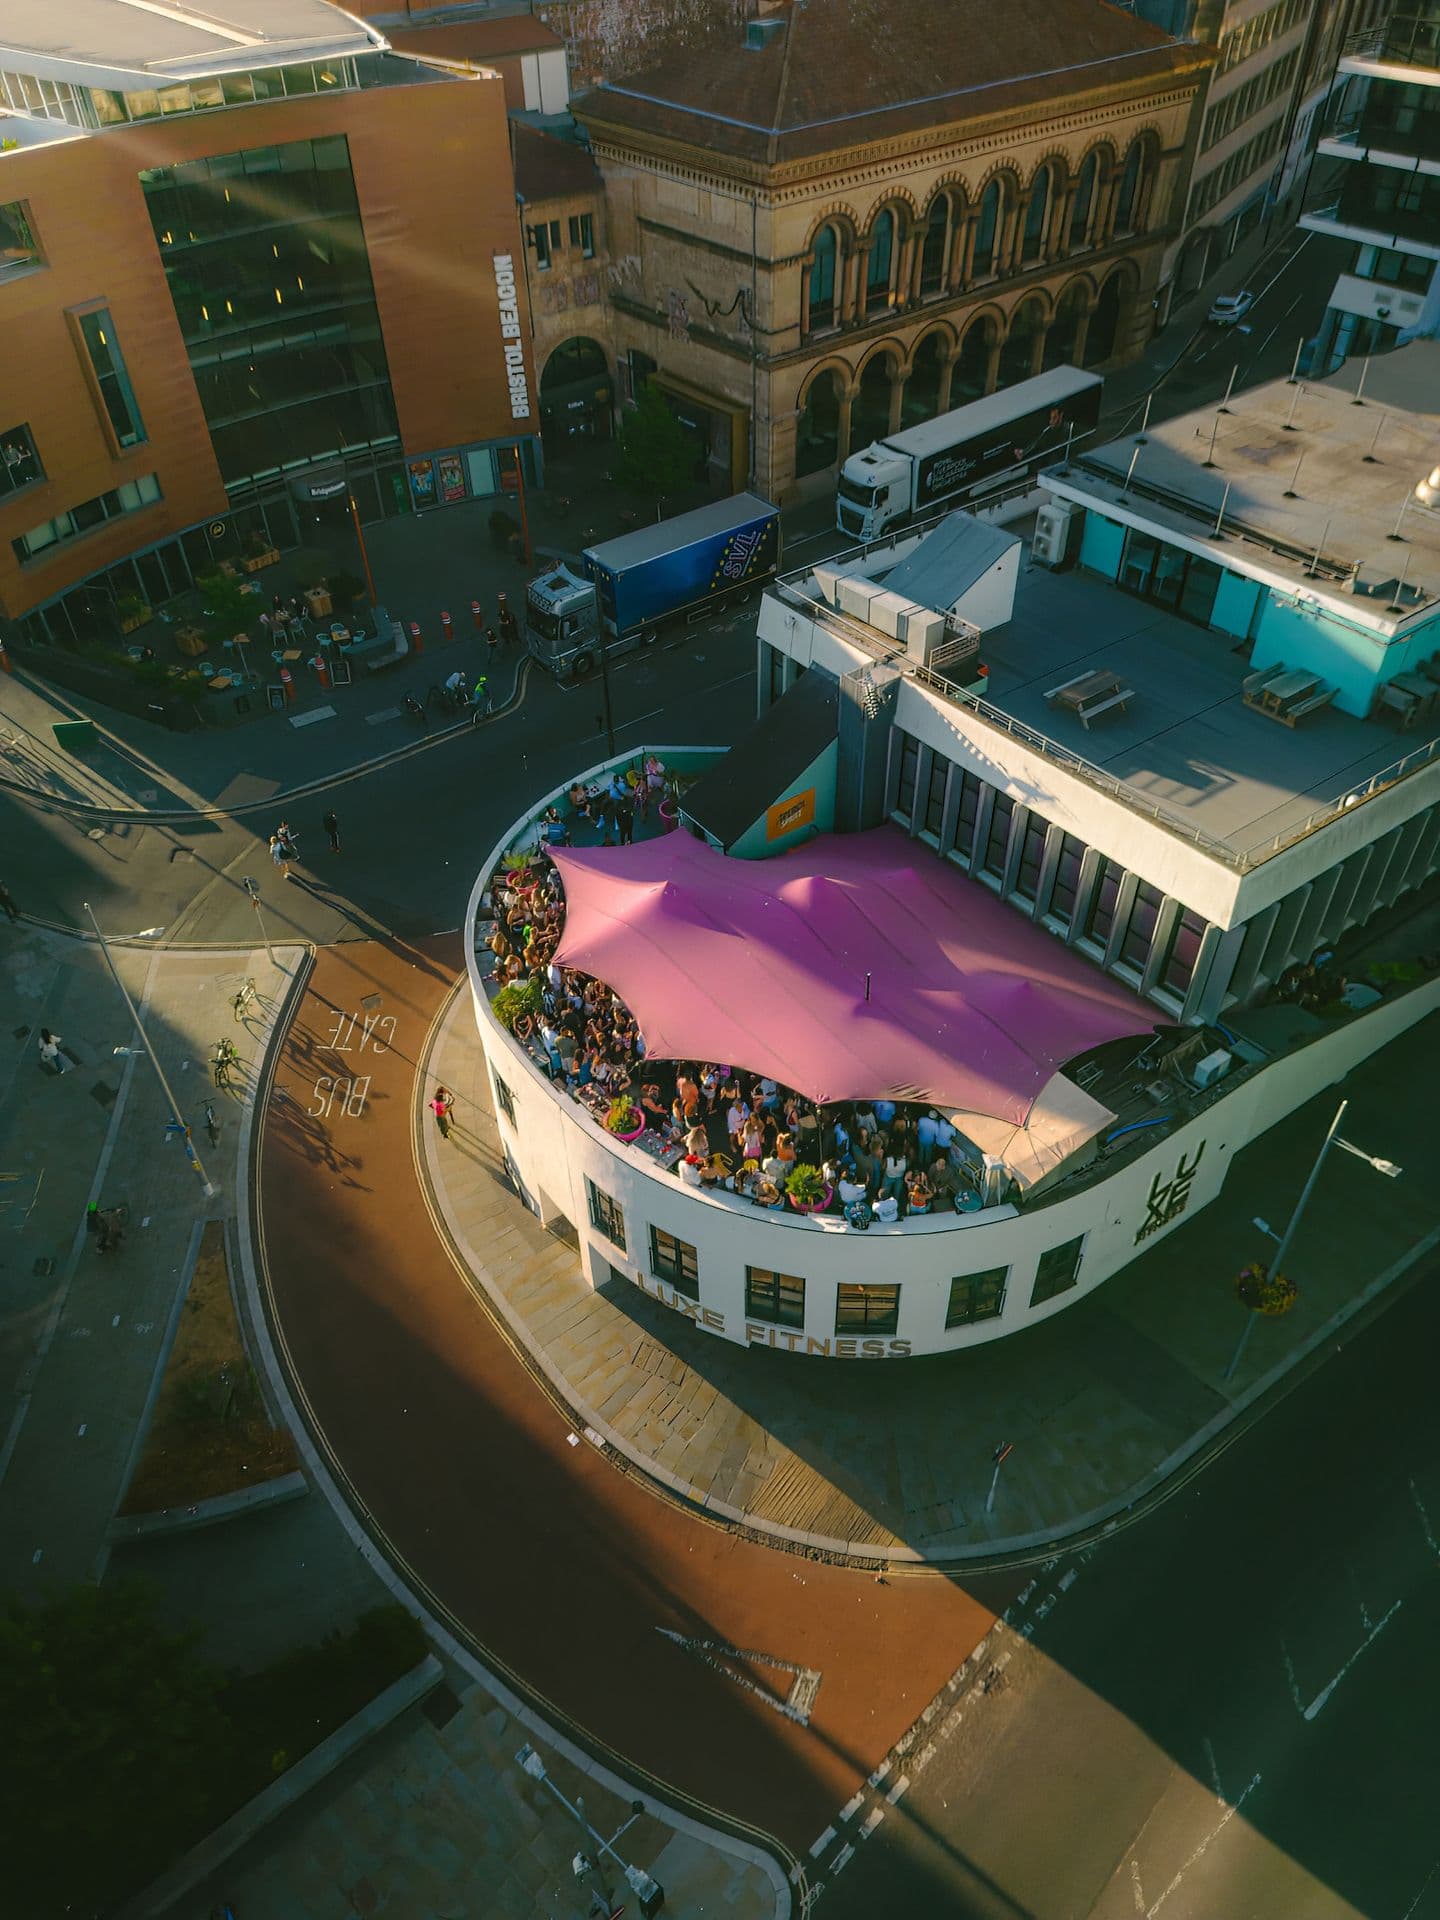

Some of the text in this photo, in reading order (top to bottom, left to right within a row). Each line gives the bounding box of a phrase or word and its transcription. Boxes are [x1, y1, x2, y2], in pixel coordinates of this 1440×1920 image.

[493, 255, 530, 418] BRISTOL BEACON
[723, 531, 756, 578] SVL
[317, 1010, 397, 1053] GATE
[308, 1076, 371, 1117] BUS
[638, 1271, 912, 1359] LUXE FITNESS
